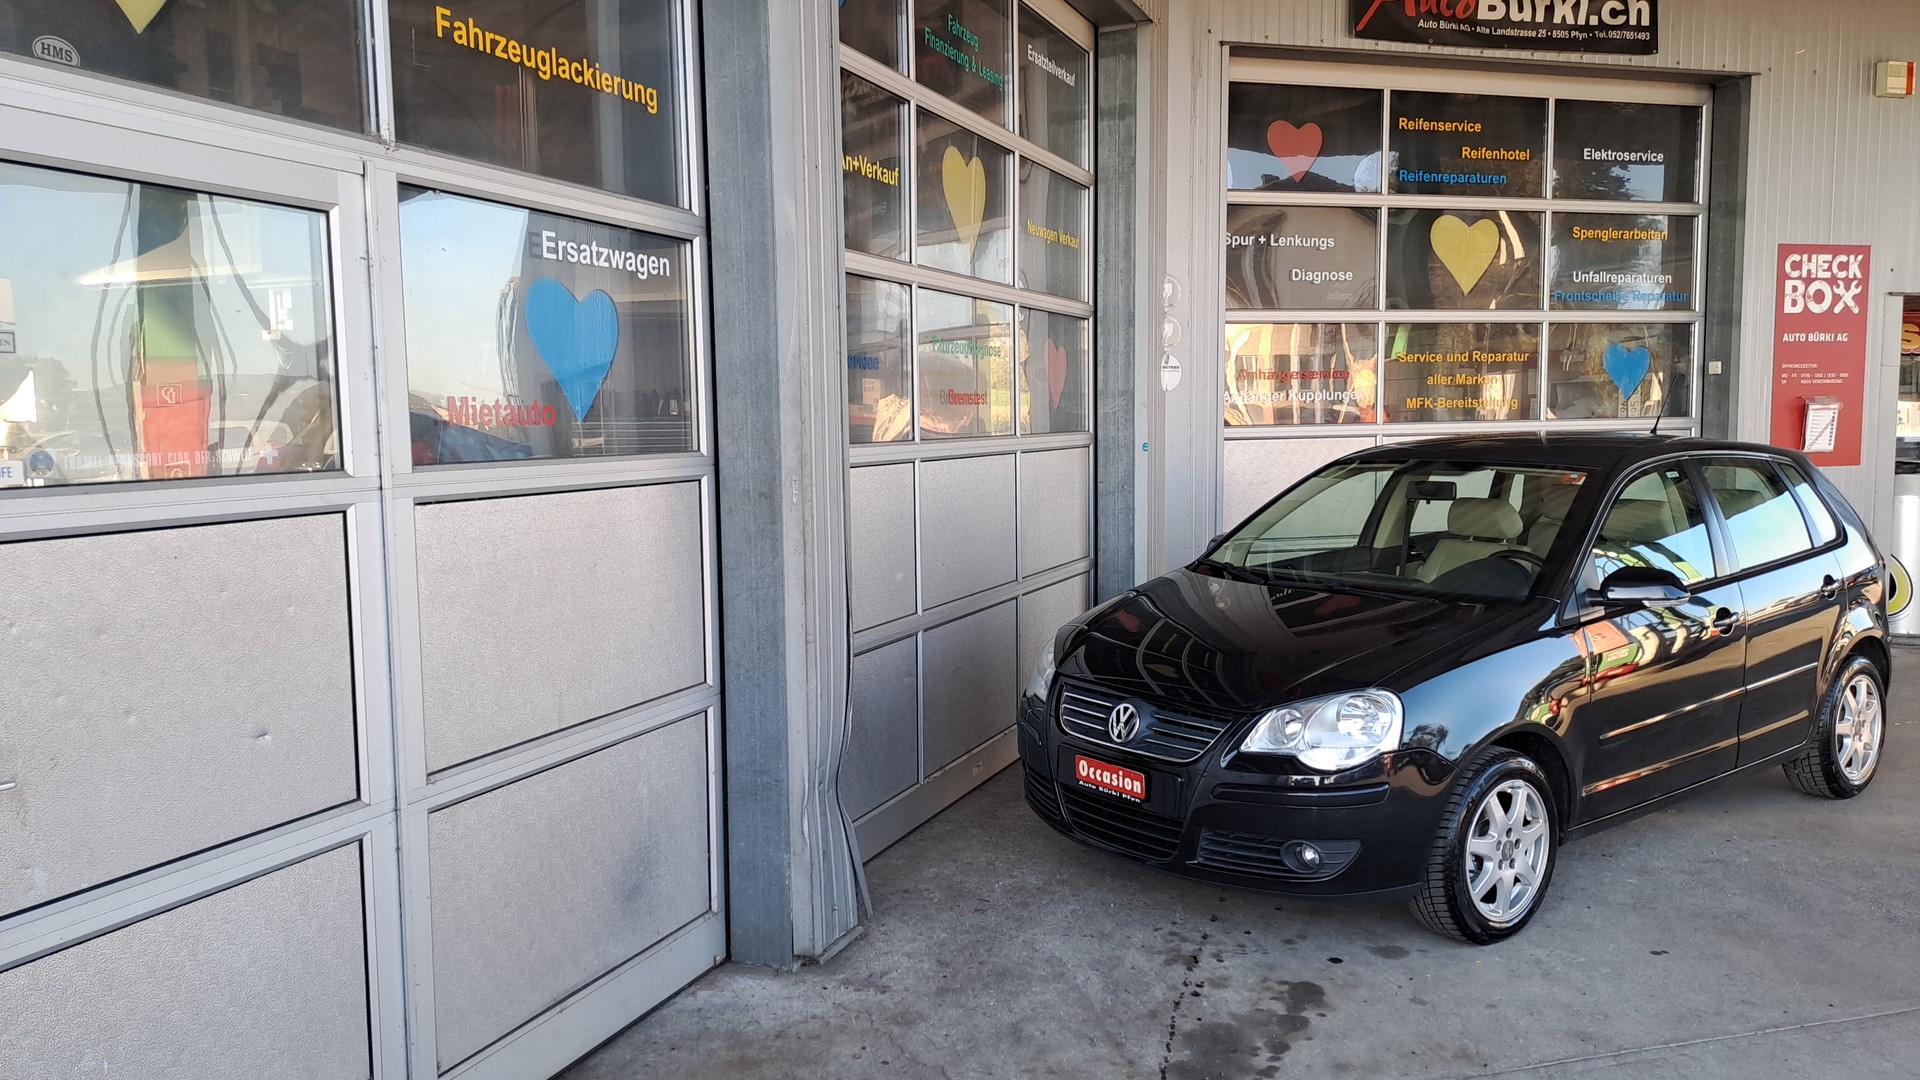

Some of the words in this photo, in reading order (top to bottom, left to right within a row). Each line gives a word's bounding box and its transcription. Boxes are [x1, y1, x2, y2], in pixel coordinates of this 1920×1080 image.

[947, 14, 980, 52] Fahrzeug
[1417, 18, 1438, 29] Auto
[1439, 19, 1459, 30] Bürki
[1460, 23, 1471, 32] AG
[1476, 25, 1490, 34] Alte
[1491, 25, 1536, 38] Landstrasse
[1537, 29, 1547, 38] 25
[1552, 30, 1569, 39] 8505
[1571, 31, 1588, 41] Pfyn
[40, 41, 73, 63] HMS
[435, 5, 658, 115] Fahrzeuglackierung
[924, 26, 969, 73] Finanzierung
[978, 58, 1004, 91] Leasing
[1027, 44, 1076, 87] Ersatzteilverkauf
[1398, 117, 1482, 133] Reifenservice
[1461, 146, 1530, 161] Reifenhotel
[1583, 147, 1664, 162] Elektroservice
[1399, 169, 1507, 185] Reifenreparaturen
[1027, 218, 1058, 244] Neuwagen
[1058, 229, 1080, 249] Verkauf
[1225, 232, 1255, 249] Spur
[1270, 233, 1335, 250] Lenkungs
[1572, 226, 1668, 241] Spenglerarbeiten
[541, 230, 670, 280] Ersatzwagen
[1784, 253, 1864, 279] CHECK
[1291, 267, 1353, 284] Diagnose
[1572, 270, 1672, 286] Unfallreparaturen
[1554, 290, 1628, 303] Frontscheibe
[1783, 279, 1863, 314] BOX
[1782, 332, 1806, 343] AUTO
[1807, 331, 1835, 343] BÜRKI
[1836, 332, 1849, 342] AG
[1399, 351, 1443, 363] Service
[1446, 351, 1468, 362] und
[1472, 350, 1530, 364] Reparatur
[1240, 367, 1350, 383] Anhängerservice
[1426, 373, 1453, 385] aller
[1455, 373, 1498, 385] Marken
[948, 388, 988, 406] Bremstest
[1223, 390, 1286, 405] Anhänger
[446, 395, 557, 427] Mietauto
[1078, 759, 1142, 795] Occasion
[1078, 780, 1097, 790] Auto
